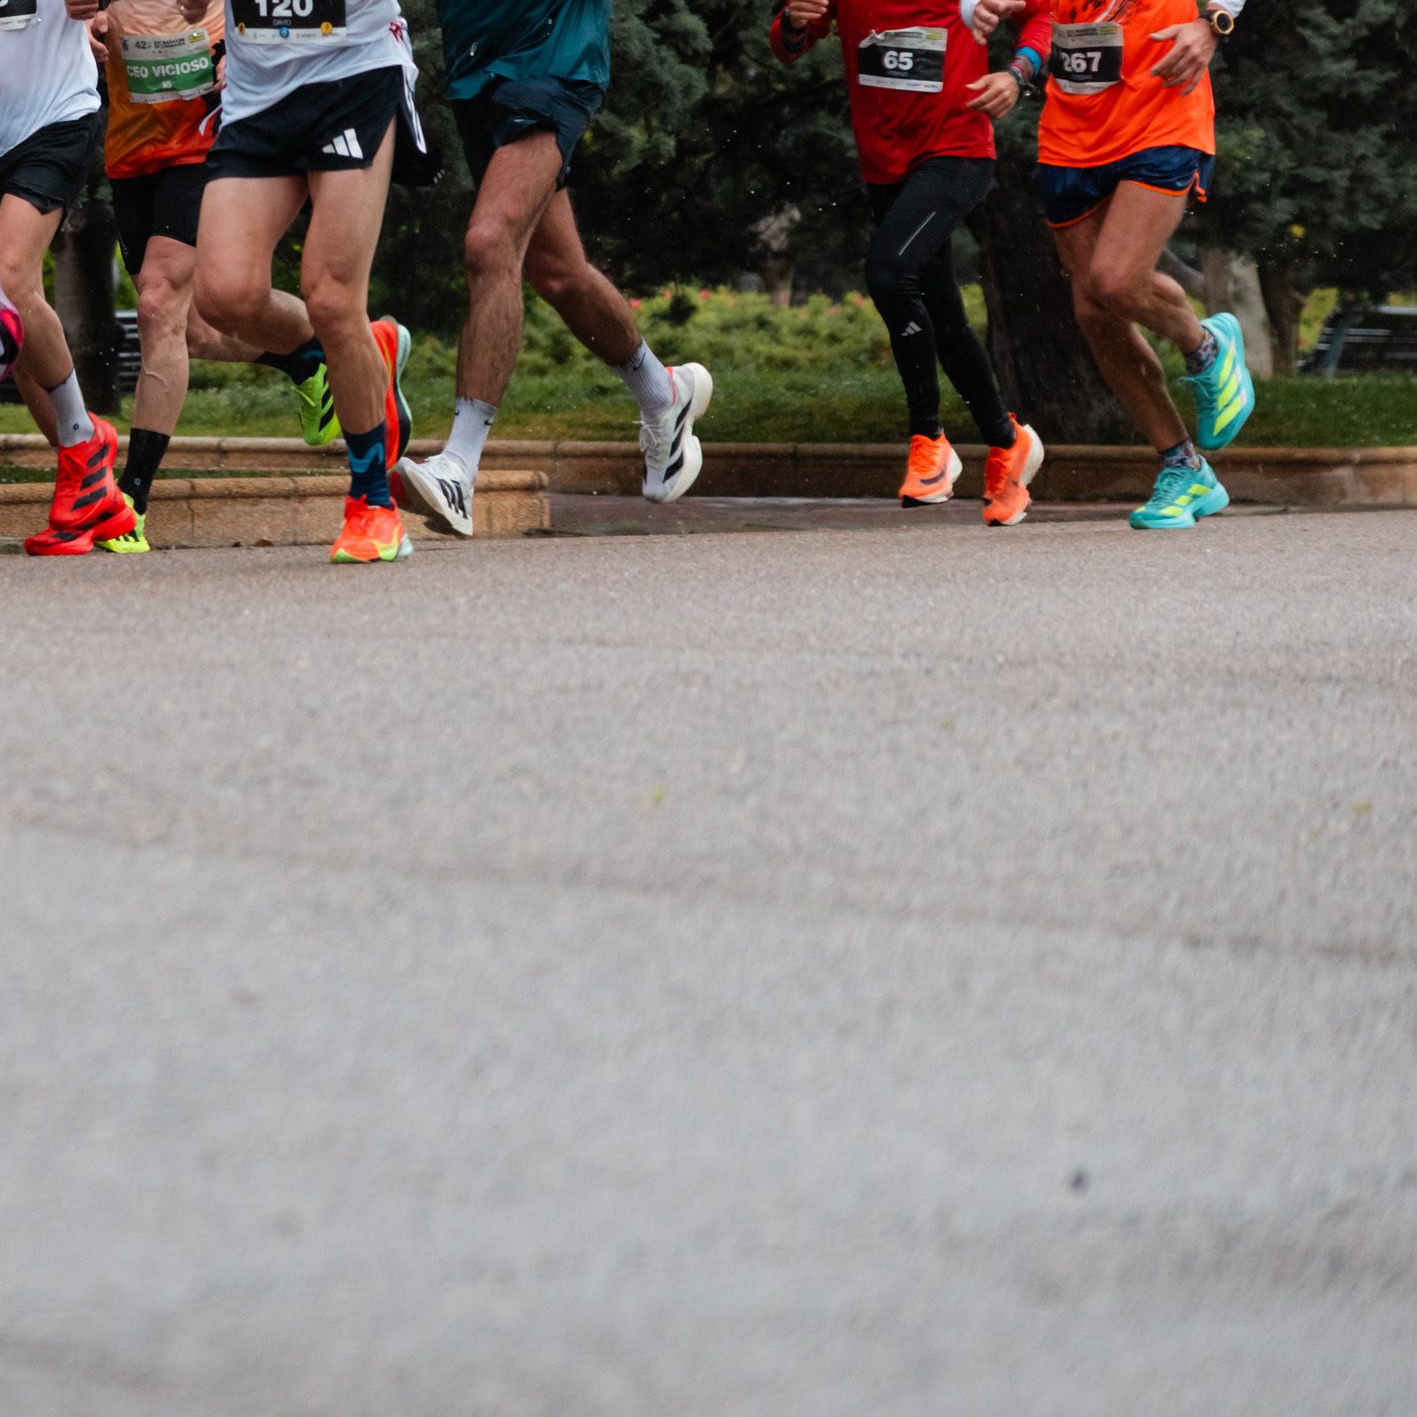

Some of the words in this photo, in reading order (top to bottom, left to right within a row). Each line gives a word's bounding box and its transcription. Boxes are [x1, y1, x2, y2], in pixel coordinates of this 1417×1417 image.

[152, 57, 209, 77] VICIOSO
[884, 50, 913, 70] 65
[1060, 51, 1102, 73] 267
